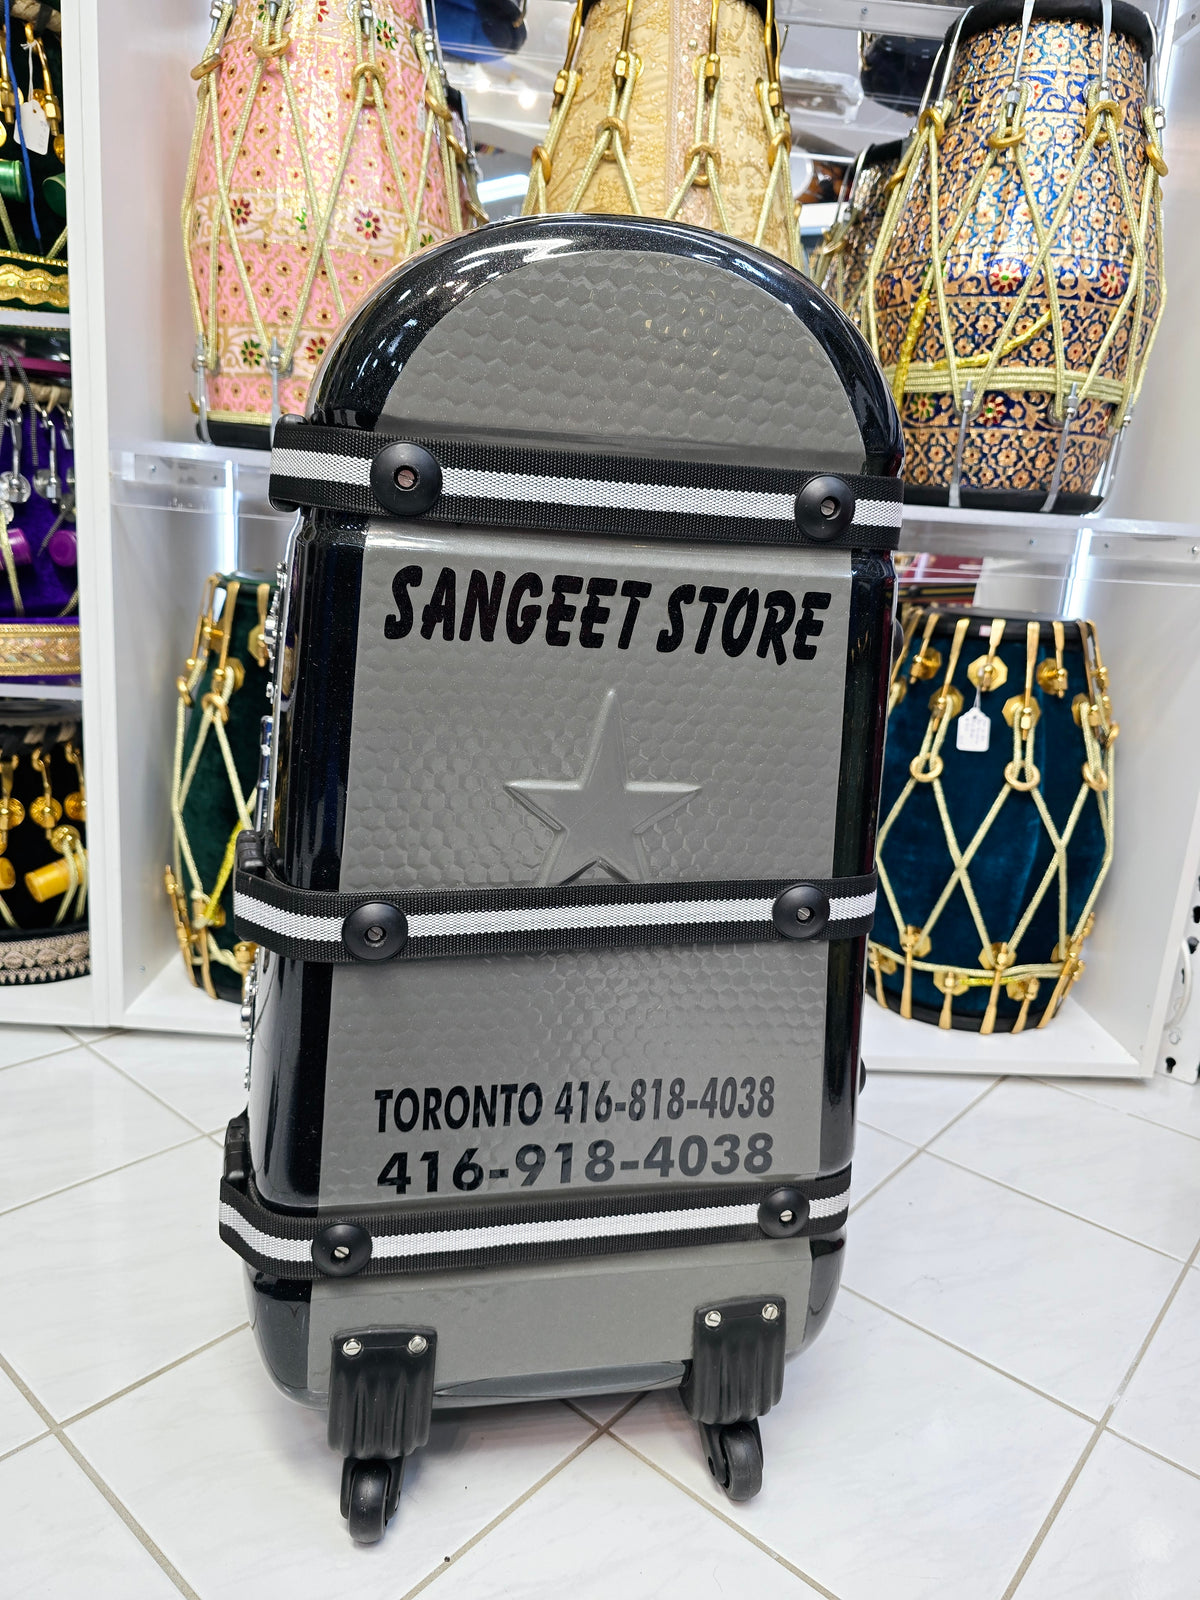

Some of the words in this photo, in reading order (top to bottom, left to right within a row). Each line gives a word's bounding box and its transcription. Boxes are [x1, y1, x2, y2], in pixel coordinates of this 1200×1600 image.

[384, 565, 652, 649] SANGEET
[656, 583, 832, 665] STORE
[374, 1082, 543, 1133] TORONTO
[554, 1076, 775, 1124] 416-818-4038
[377, 1132, 773, 1195] 416-918-4038
